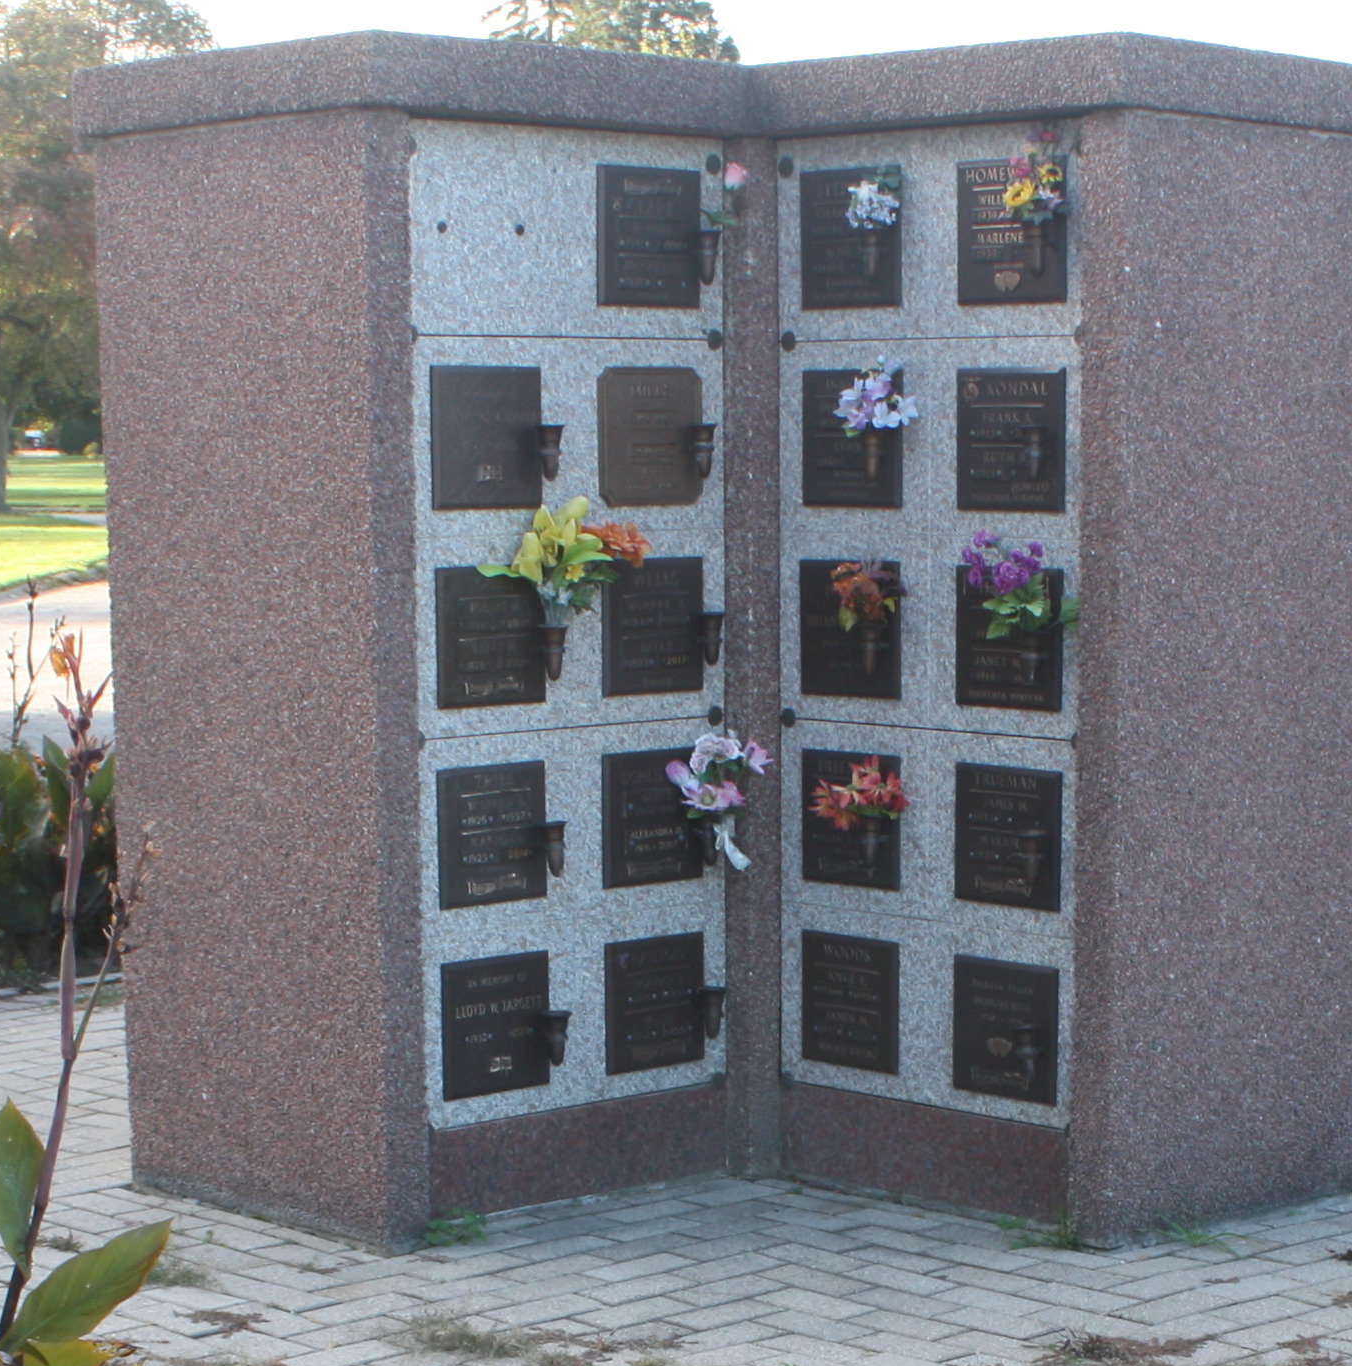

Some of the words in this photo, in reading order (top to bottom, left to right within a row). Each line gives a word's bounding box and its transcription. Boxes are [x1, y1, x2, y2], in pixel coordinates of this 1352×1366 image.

[977, 192, 1003, 206] WILL
[976, 231, 1024, 245] MARLENE
[974, 772, 1038, 791] TRUEMAN
[823, 943, 872, 962] WOODS
[455, 1003, 486, 1020] LLOYD
